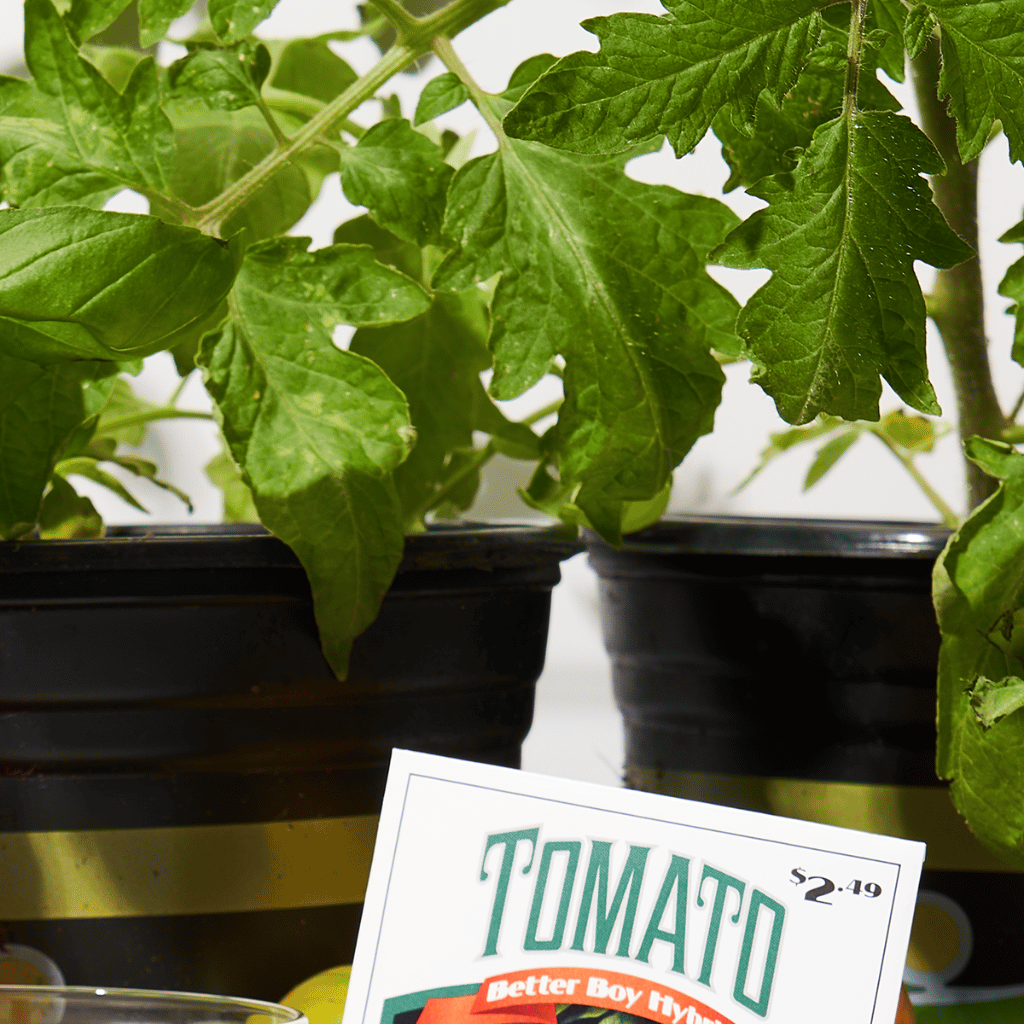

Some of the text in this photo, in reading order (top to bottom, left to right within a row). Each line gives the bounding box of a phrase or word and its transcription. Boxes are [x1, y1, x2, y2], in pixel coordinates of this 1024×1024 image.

[789, 866, 883, 906] $2.49
[479, 826, 786, 1018] TOMATO
[486, 974, 581, 1003] Better
[586, 976, 643, 1009] Boy
